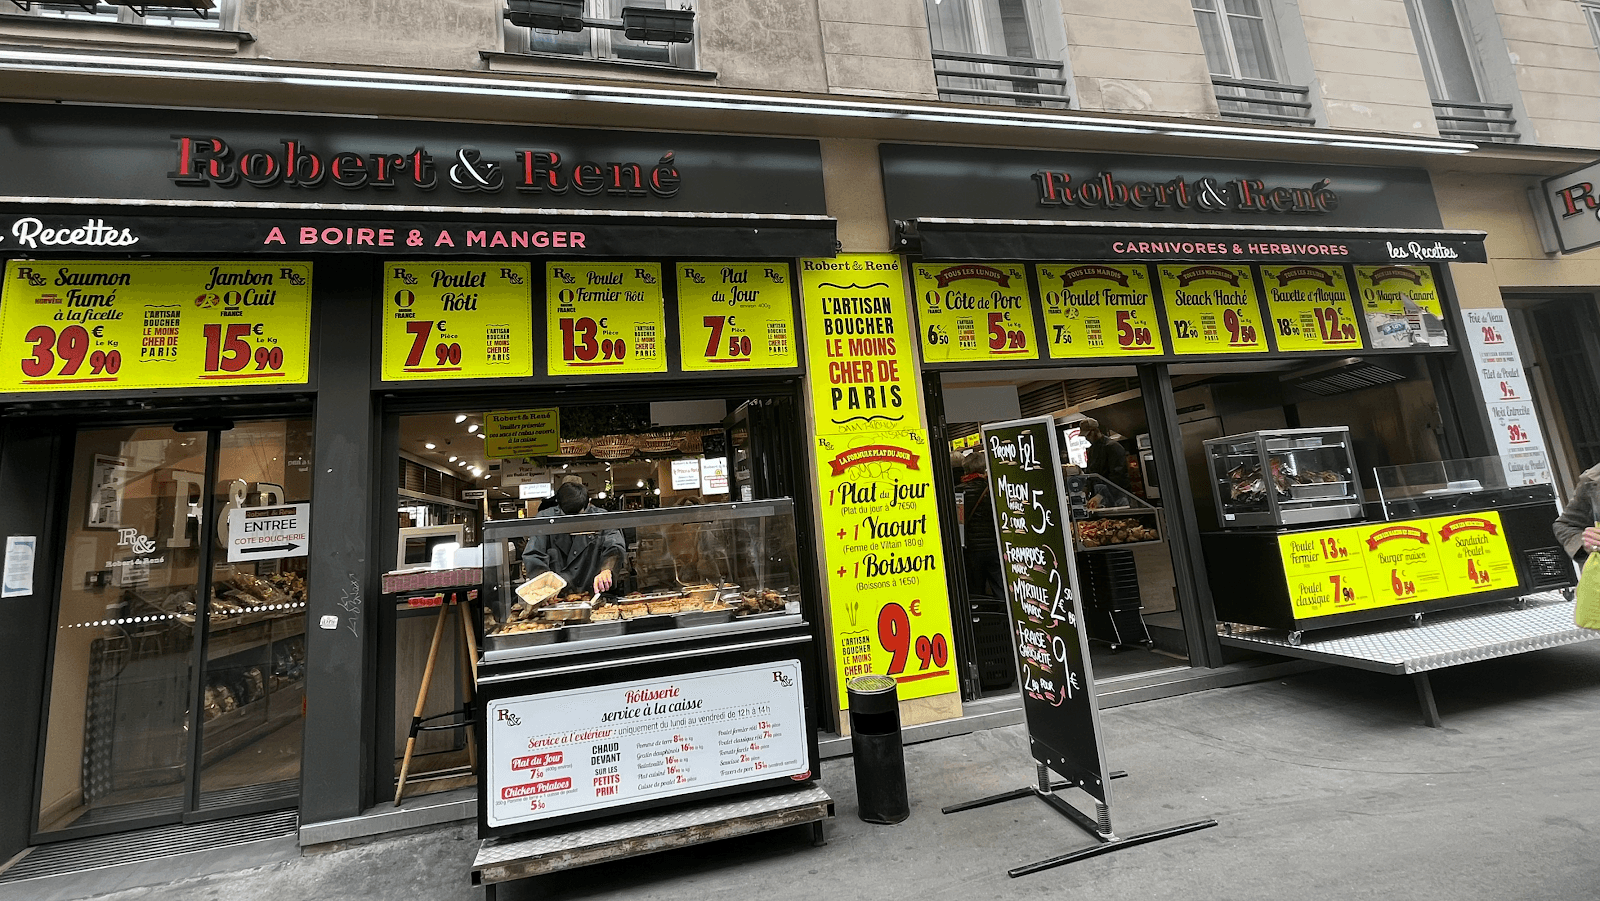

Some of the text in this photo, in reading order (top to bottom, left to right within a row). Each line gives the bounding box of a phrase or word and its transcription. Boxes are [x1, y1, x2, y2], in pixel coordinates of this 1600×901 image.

[168, 134, 680, 197] Robert & René
[1031, 170, 1339, 214] Robert & René
[12, 217, 139, 249] Recettes
[264, 227, 586, 249] A BOIRE & A MANGER
[1112, 241, 1349, 256] CARNIVORES & HERBIVORES
[1386, 241, 1458, 261] les Recettes
[803, 260, 899, 271] Robert & René
[54, 267, 131, 287] Saumon
[204, 266, 273, 290] Jambon
[430, 269, 487, 287] Poulet
[586, 270, 623, 285] Poulet
[720, 266, 748, 284] Plat
[944, 269, 961, 279] TOUS
[976, 268, 1000, 279] LUNDIS
[1066, 270, 1084, 280] TOUS
[1097, 269, 1121, 279] MARDIS
[66, 288, 117, 307] Fumé
[243, 288, 277, 306] Cuit
[441, 292, 478, 311] Rôti
[576, 287, 645, 302] Fermier Rôti
[711, 285, 760, 306] du Jour
[945, 290, 1022, 310] Côte de Porc
[1060, 288, 1149, 306] Poulet Fermier
[1175, 289, 1248, 306] Steack Haché
[1271, 287, 1306, 302] Bavette
[821, 297, 892, 315] L'ARTISAN
[54, 308, 65, 321] à
[144, 310, 181, 318] L'ARTISAN
[143, 319, 181, 327] BOUCHER
[824, 317, 894, 335] BOUCHER
[143, 327, 180, 336] LE MOINS
[142, 337, 179, 346] CHER DE
[826, 337, 897, 357] LE MOINS
[141, 347, 178, 357] PARIS
[828, 359, 900, 385] CHER DE
[831, 385, 902, 411] PARIS
[887, 449, 896, 457] DU
[837, 481, 877, 505] Plat
[880, 490, 890, 499] du
[889, 478, 930, 507] jour
[858, 505, 868, 514] du
[869, 504, 883, 515] jour
[884, 503, 890, 512] à
[244, 518, 297, 533] ENTREE
[862, 514, 927, 540] Yaourt
[234, 533, 306, 546] COTE BOUCHERIE
[870, 541, 879, 550] de
[880, 539, 902, 550] Viltain
[1290, 540, 1315, 553] Poulet
[1455, 534, 1489, 548] Sandwich
[1290, 552, 1319, 564] Fermier
[1378, 552, 1403, 566] Burger
[1463, 546, 1485, 558] Poulet
[862, 552, 936, 578] Boisson
[892, 577, 897, 587] à
[1298, 581, 1322, 595] Poulet
[1296, 594, 1330, 607] classique
[624, 685, 680, 704] Rôtisserie
[601, 698, 703, 723] service à la caisse
[528, 737, 558, 749] Service
[561, 734, 567, 744] à
[569, 729, 612, 742] l'extérieur
[618, 723, 659, 736] uniquement
[660, 720, 669, 729] du
[670, 717, 687, 728] lundi
[688, 717, 697, 725] au
[698, 713, 726, 724] vendredi
[727, 710, 736, 719] de
[752, 707, 757, 715] à
[592, 742, 619, 754] CHAUD
[512, 752, 563, 768] Plat du Jour
[590, 752, 621, 766] DEVANT
[594, 765, 618, 776] SUR LES
[593, 773, 620, 786] PETITS
[504, 786, 535, 799] Chicken
[536, 779, 569, 794] Potatoes
[595, 784, 614, 798] PRIX
